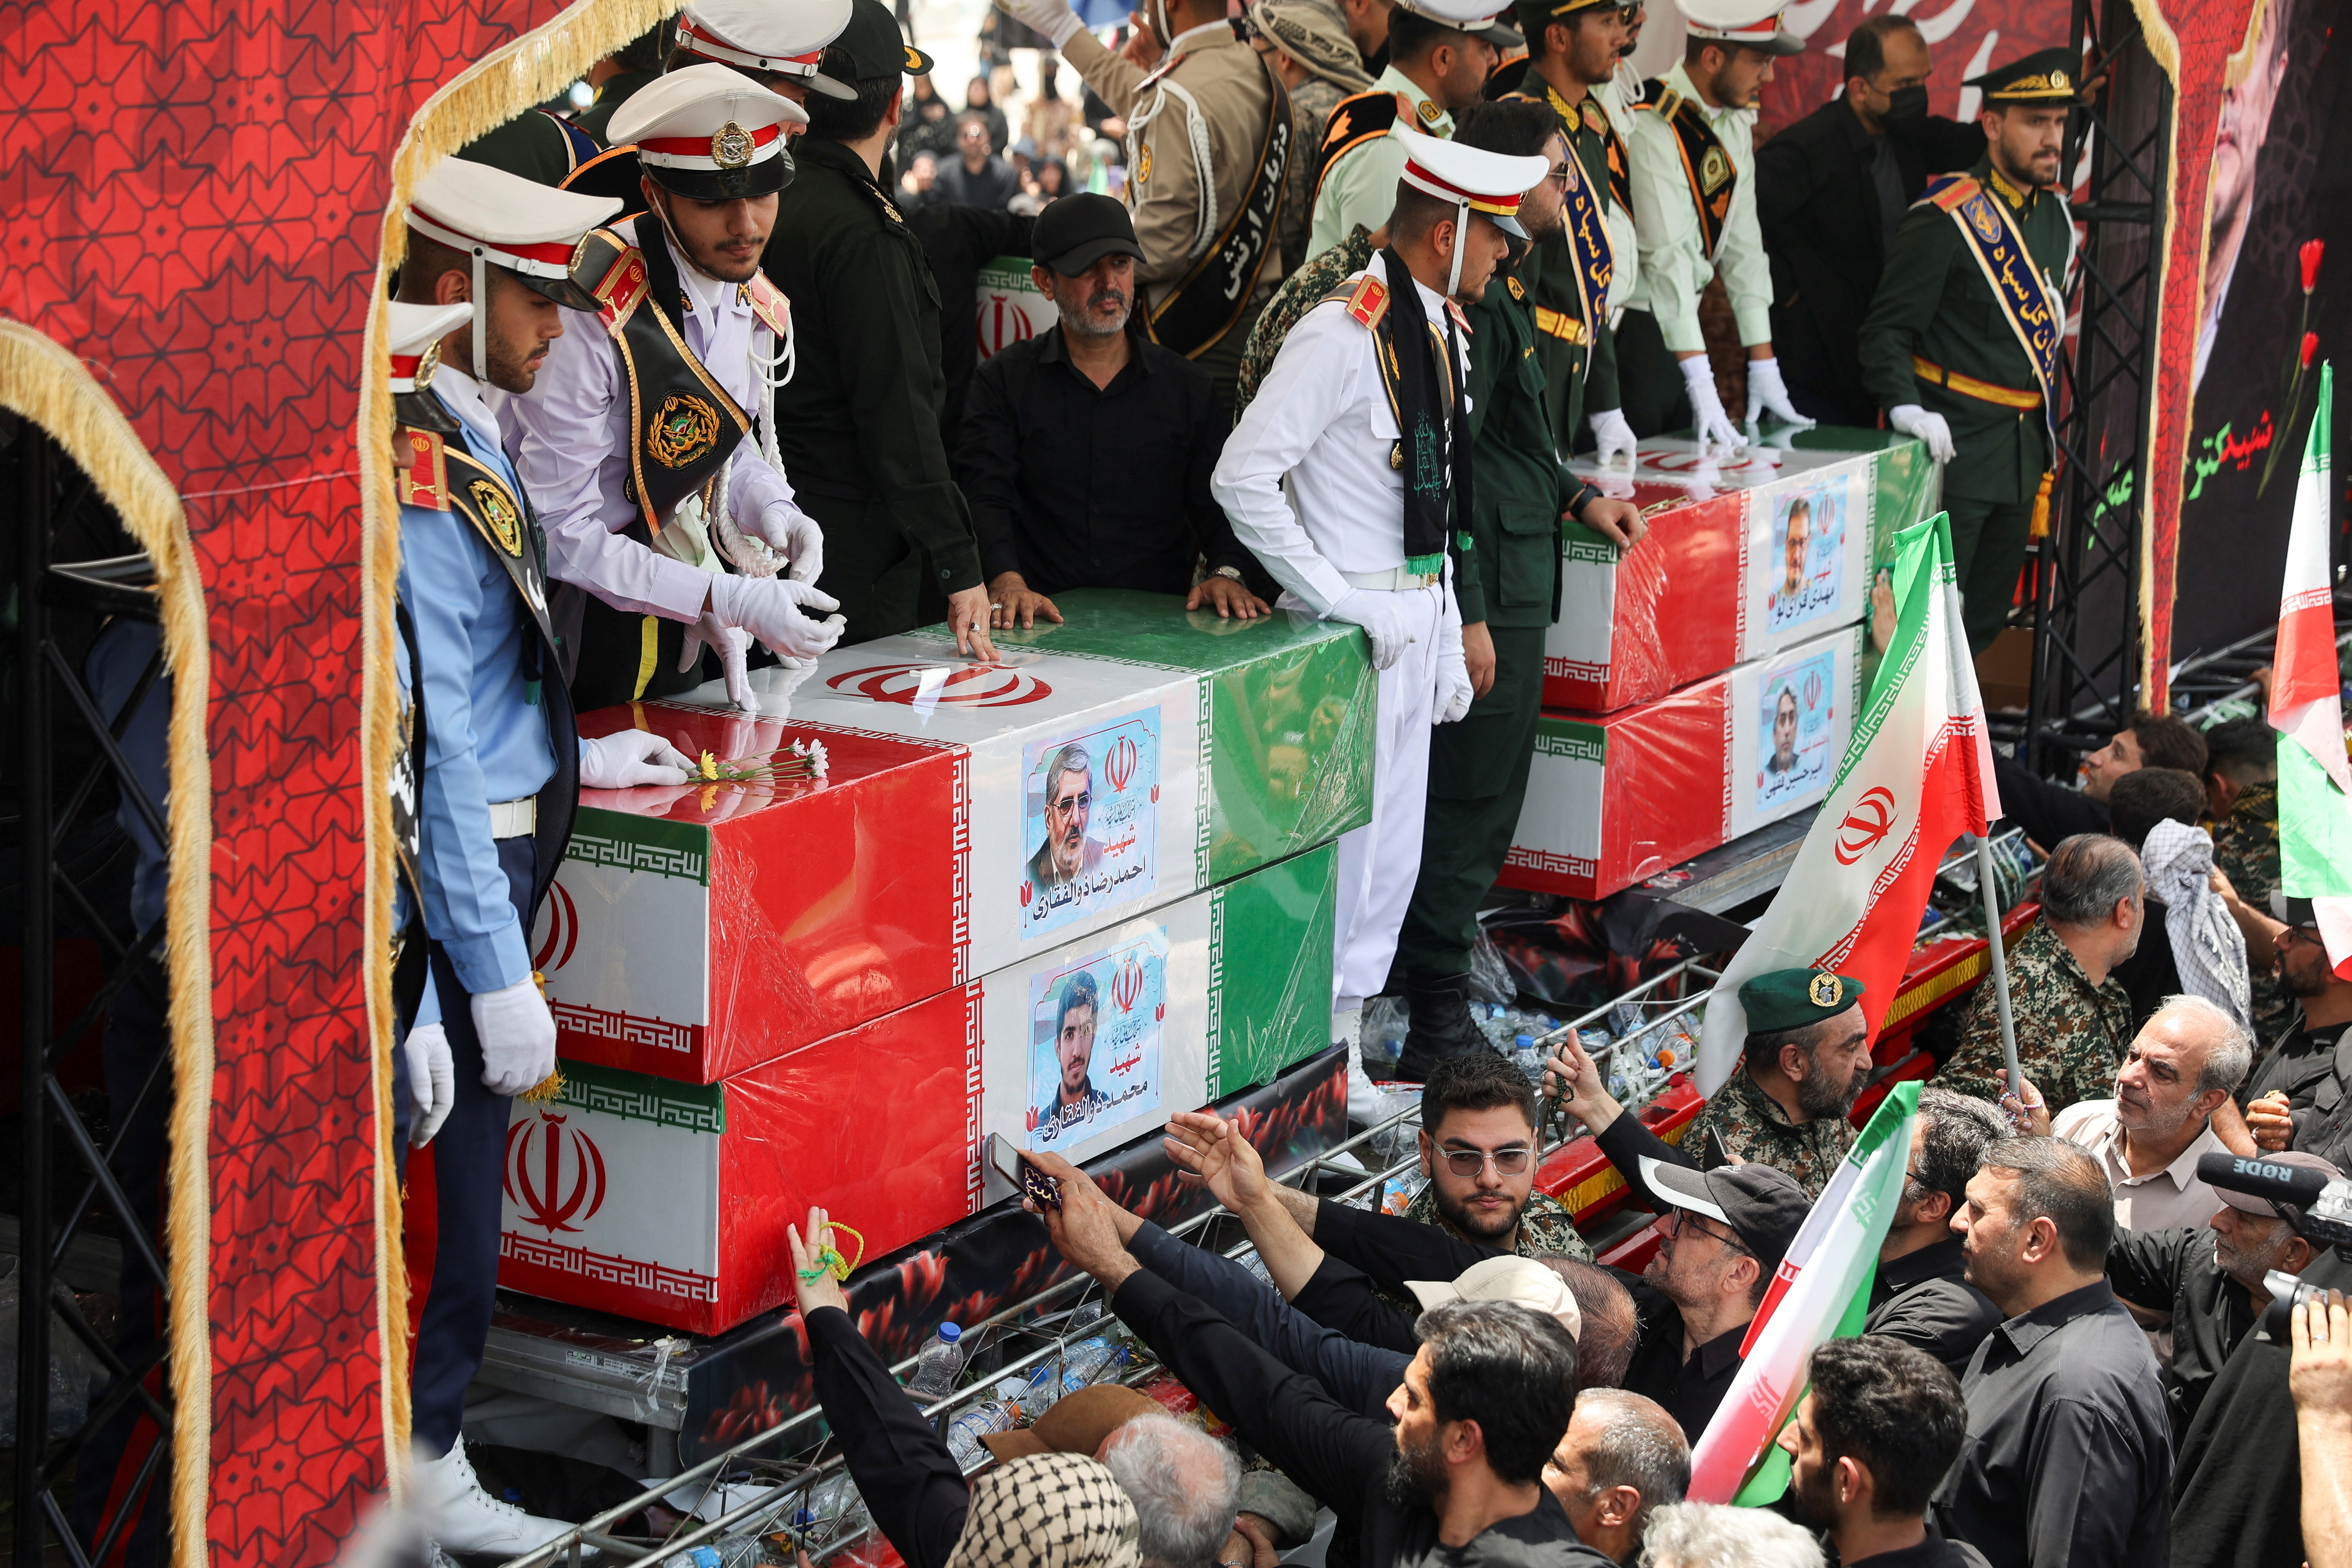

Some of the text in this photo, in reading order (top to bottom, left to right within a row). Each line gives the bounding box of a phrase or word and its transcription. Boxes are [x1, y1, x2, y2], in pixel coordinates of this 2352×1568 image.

[1575, 195, 1601, 259] سپاه
[1224, 208, 1263, 300] ارتش
[1993, 245, 2030, 301] سپاه
[2020, 302, 2049, 326] کل
[2188, 409, 2274, 500] شهید کتر
[1810, 586, 1834, 609] مهدی
[1103, 824, 1136, 858] شهید
[1032, 874, 1090, 921] ذوالفقاری
[1110, 1042, 1142, 1077] شهید
[1042, 1079, 1148, 1142] محمد ذوالفقاری
